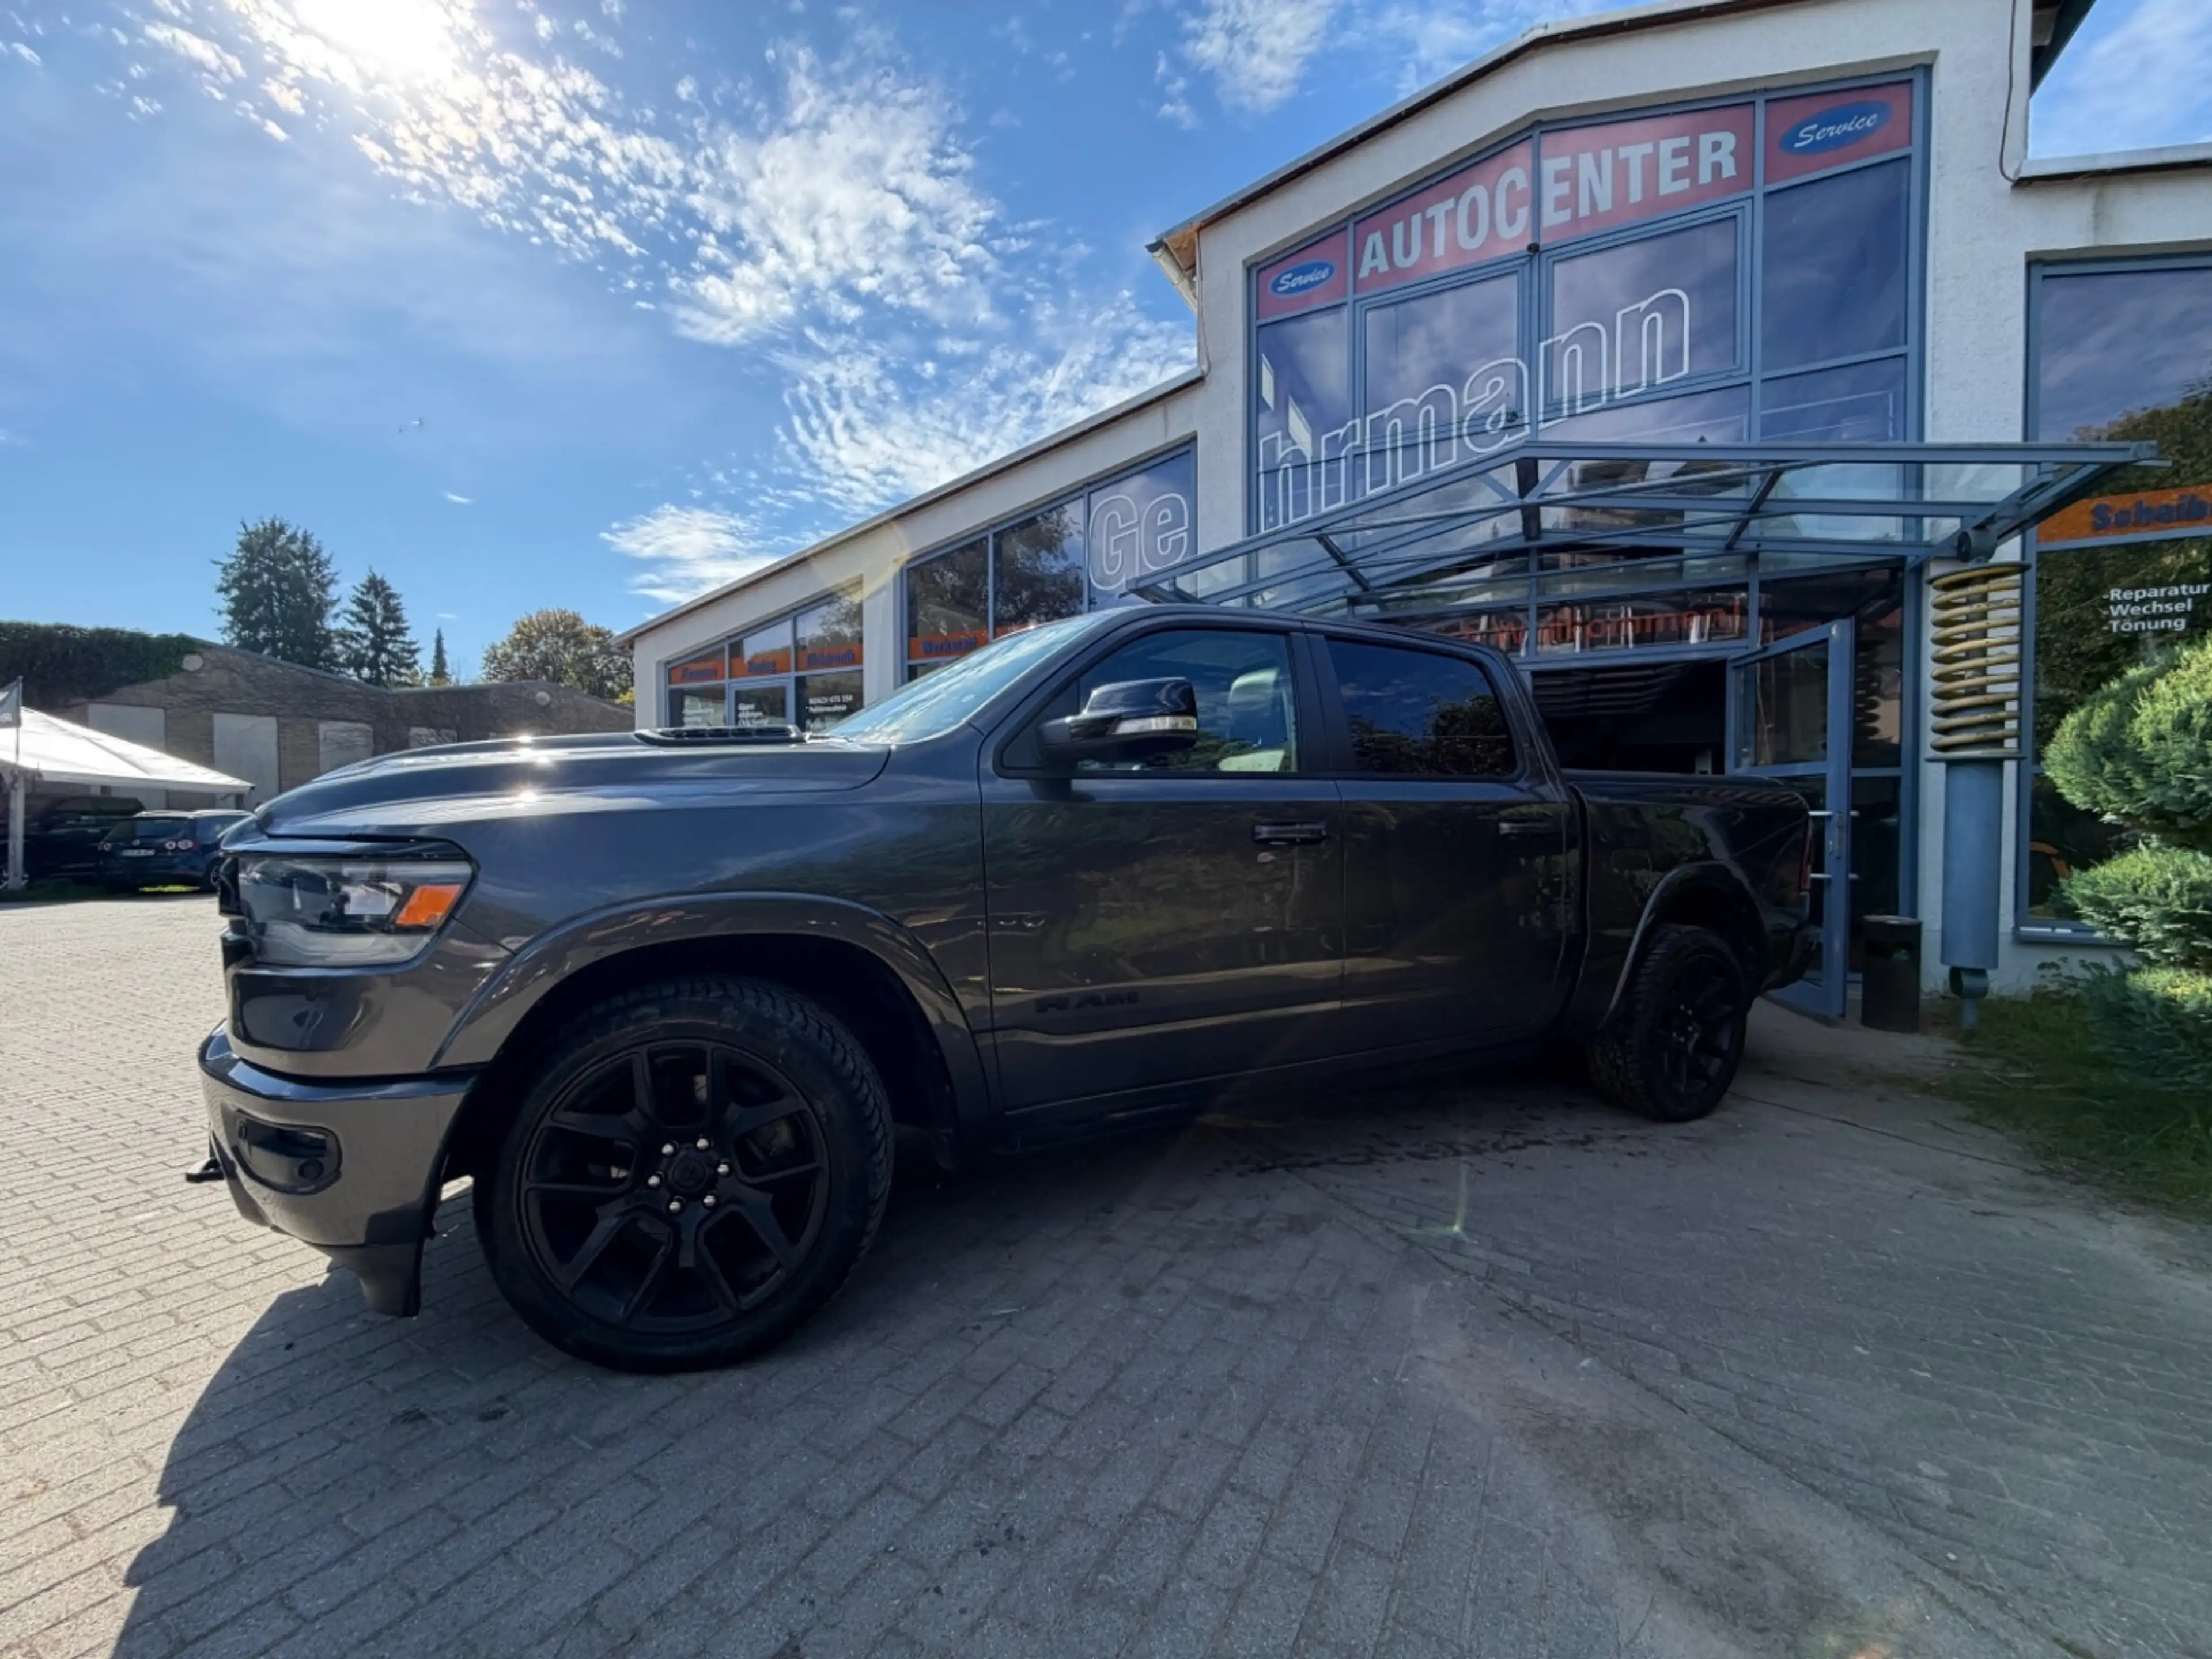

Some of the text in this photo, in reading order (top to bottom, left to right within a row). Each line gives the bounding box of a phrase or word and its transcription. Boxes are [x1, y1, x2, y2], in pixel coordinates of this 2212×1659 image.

[1794, 113, 1878, 149] Service
[1358, 130, 1737, 279] AUTOCENTER
[1277, 267, 1330, 292] Service
